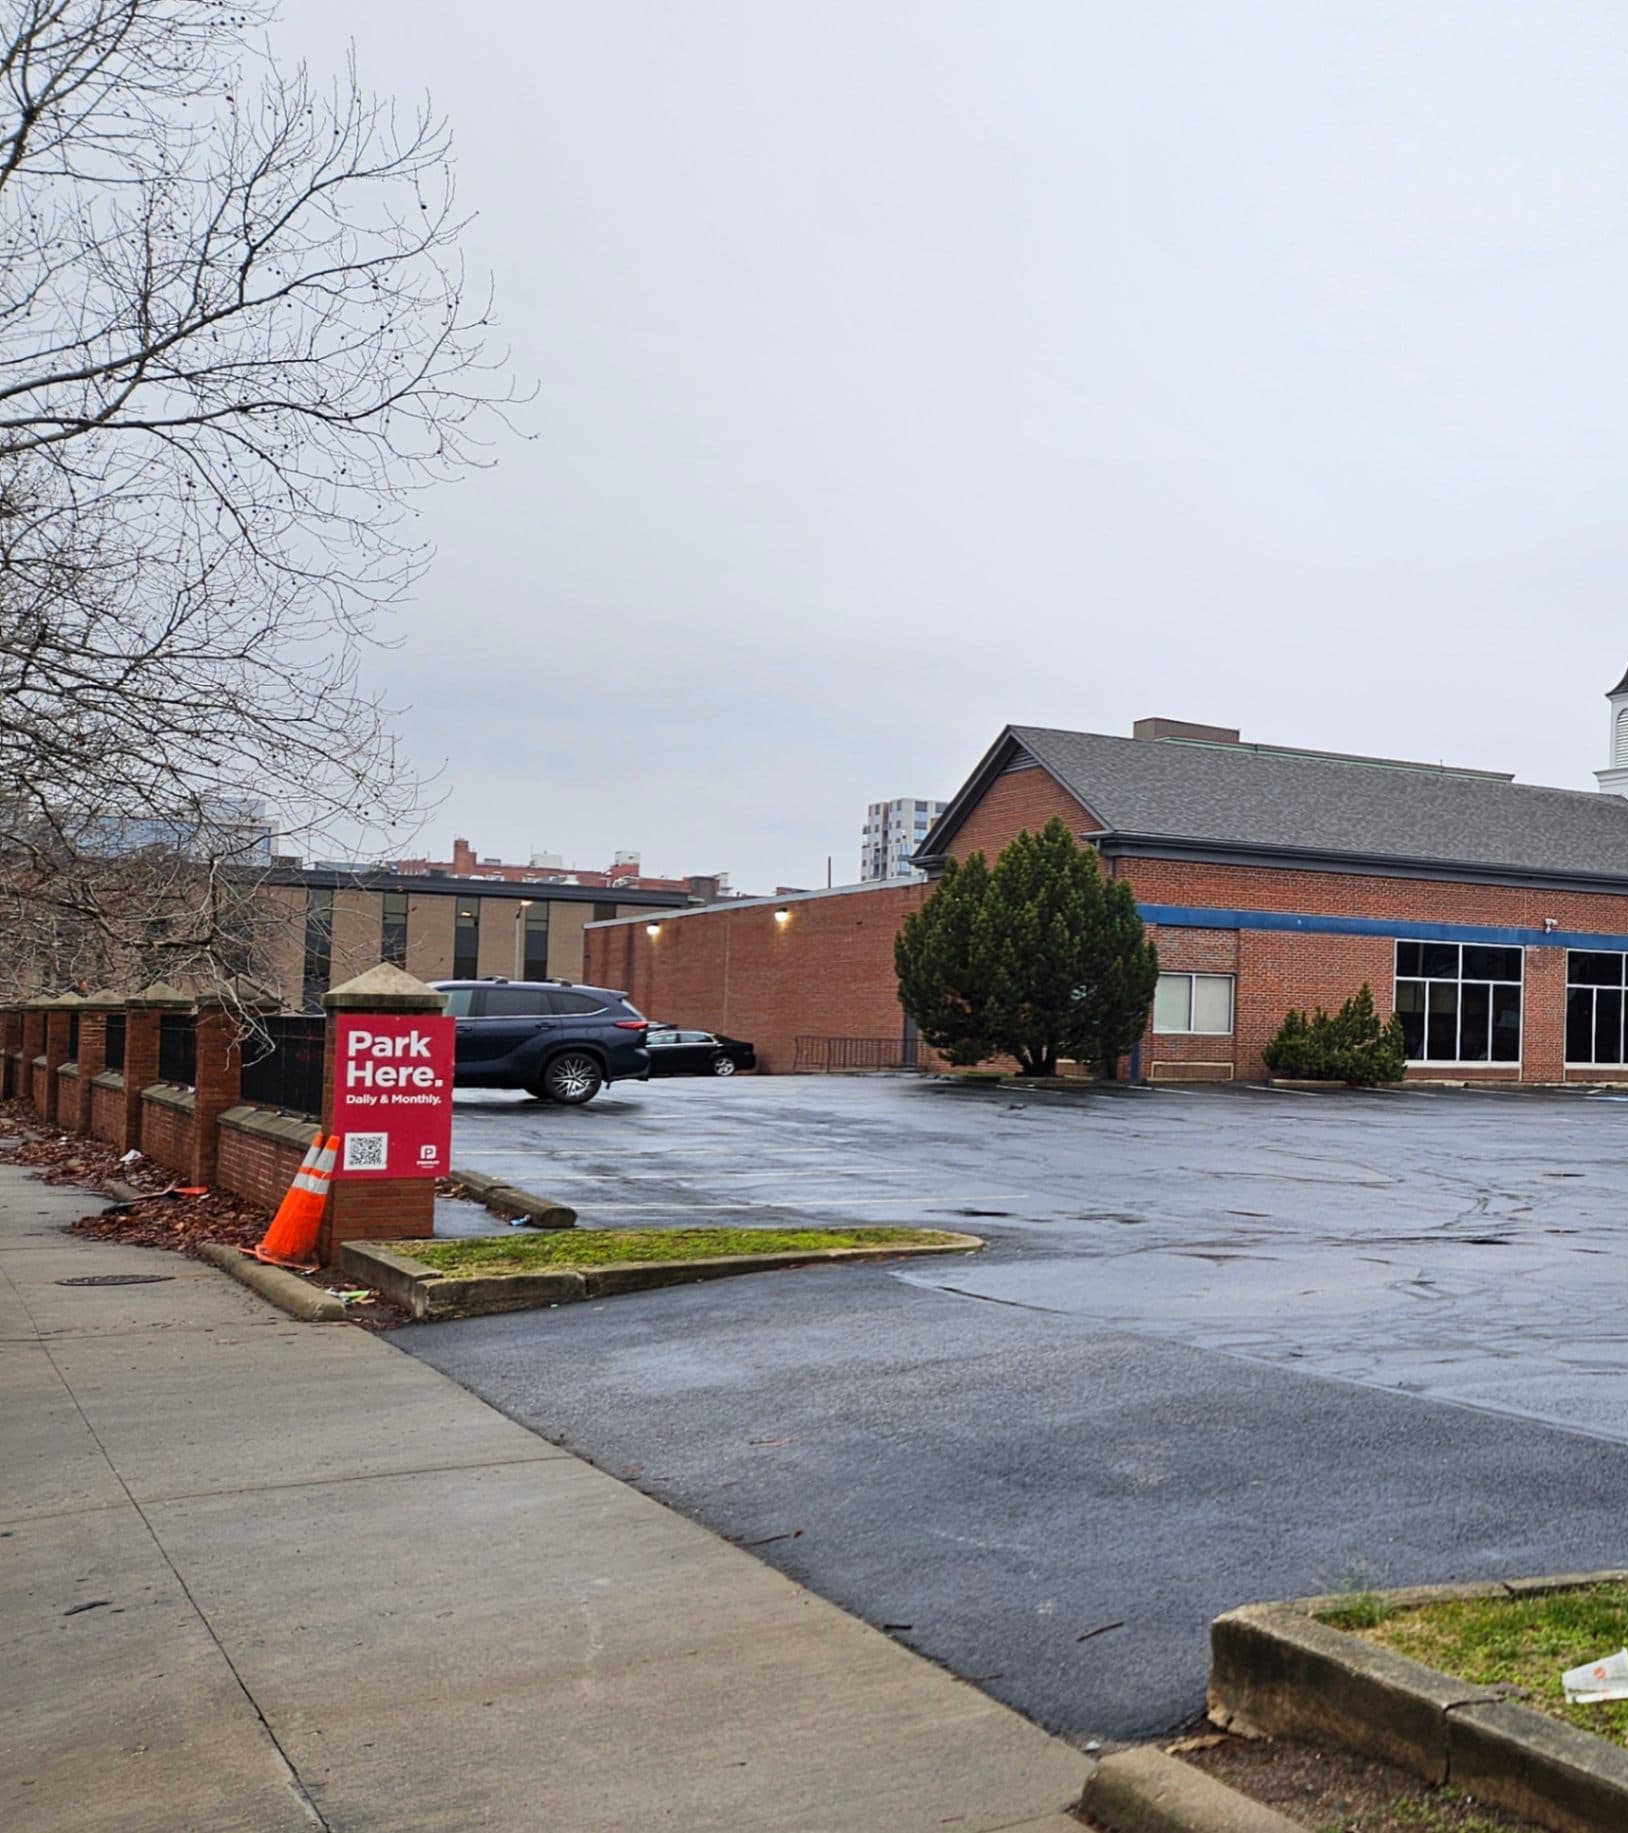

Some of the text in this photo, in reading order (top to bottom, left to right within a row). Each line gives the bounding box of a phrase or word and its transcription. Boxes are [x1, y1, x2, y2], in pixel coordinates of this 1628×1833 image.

[348, 1030, 431, 1057] Park
[346, 1061, 443, 1087] Here.
[346, 1094, 442, 1105] Daily & Monthly.
